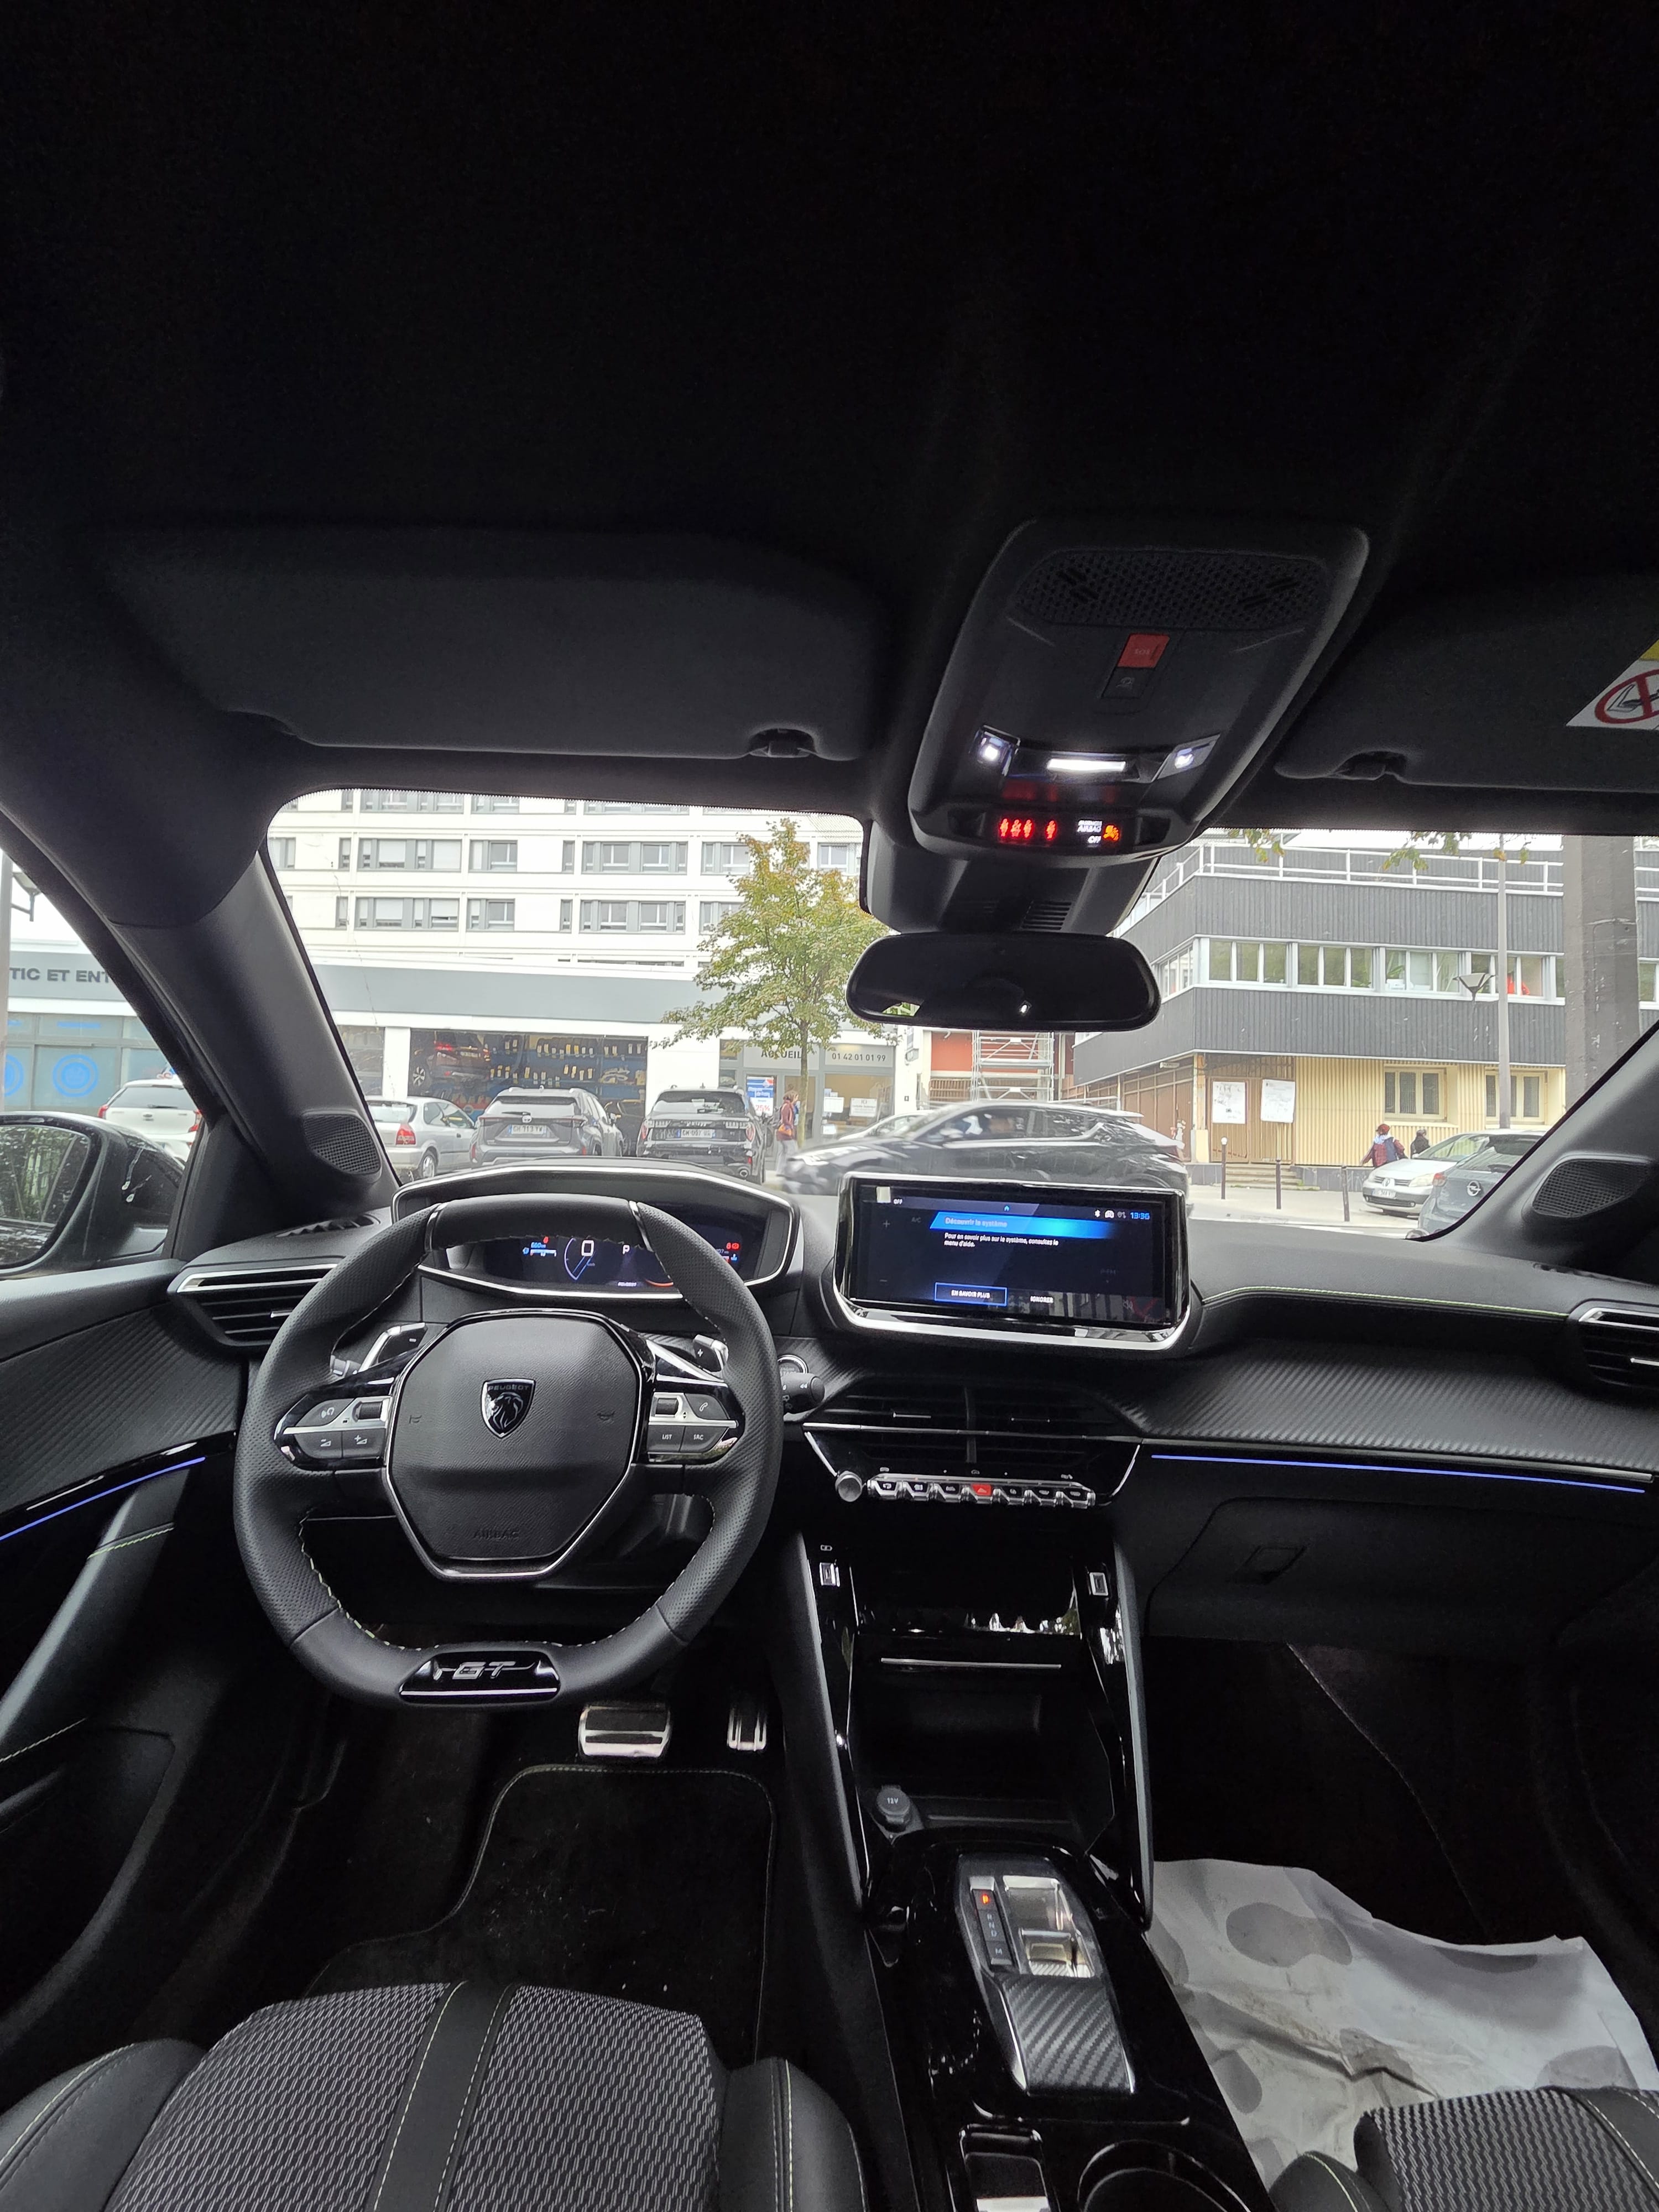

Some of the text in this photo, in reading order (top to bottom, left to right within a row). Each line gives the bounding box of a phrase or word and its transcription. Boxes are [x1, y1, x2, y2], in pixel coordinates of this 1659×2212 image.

[47, 969, 70, 982] ET
[581, 1240, 594, 1256] 0
[623, 1245, 630, 1255] P
[452, 1662, 517, 1679] GT
[982, 1895, 989, 1903] P
